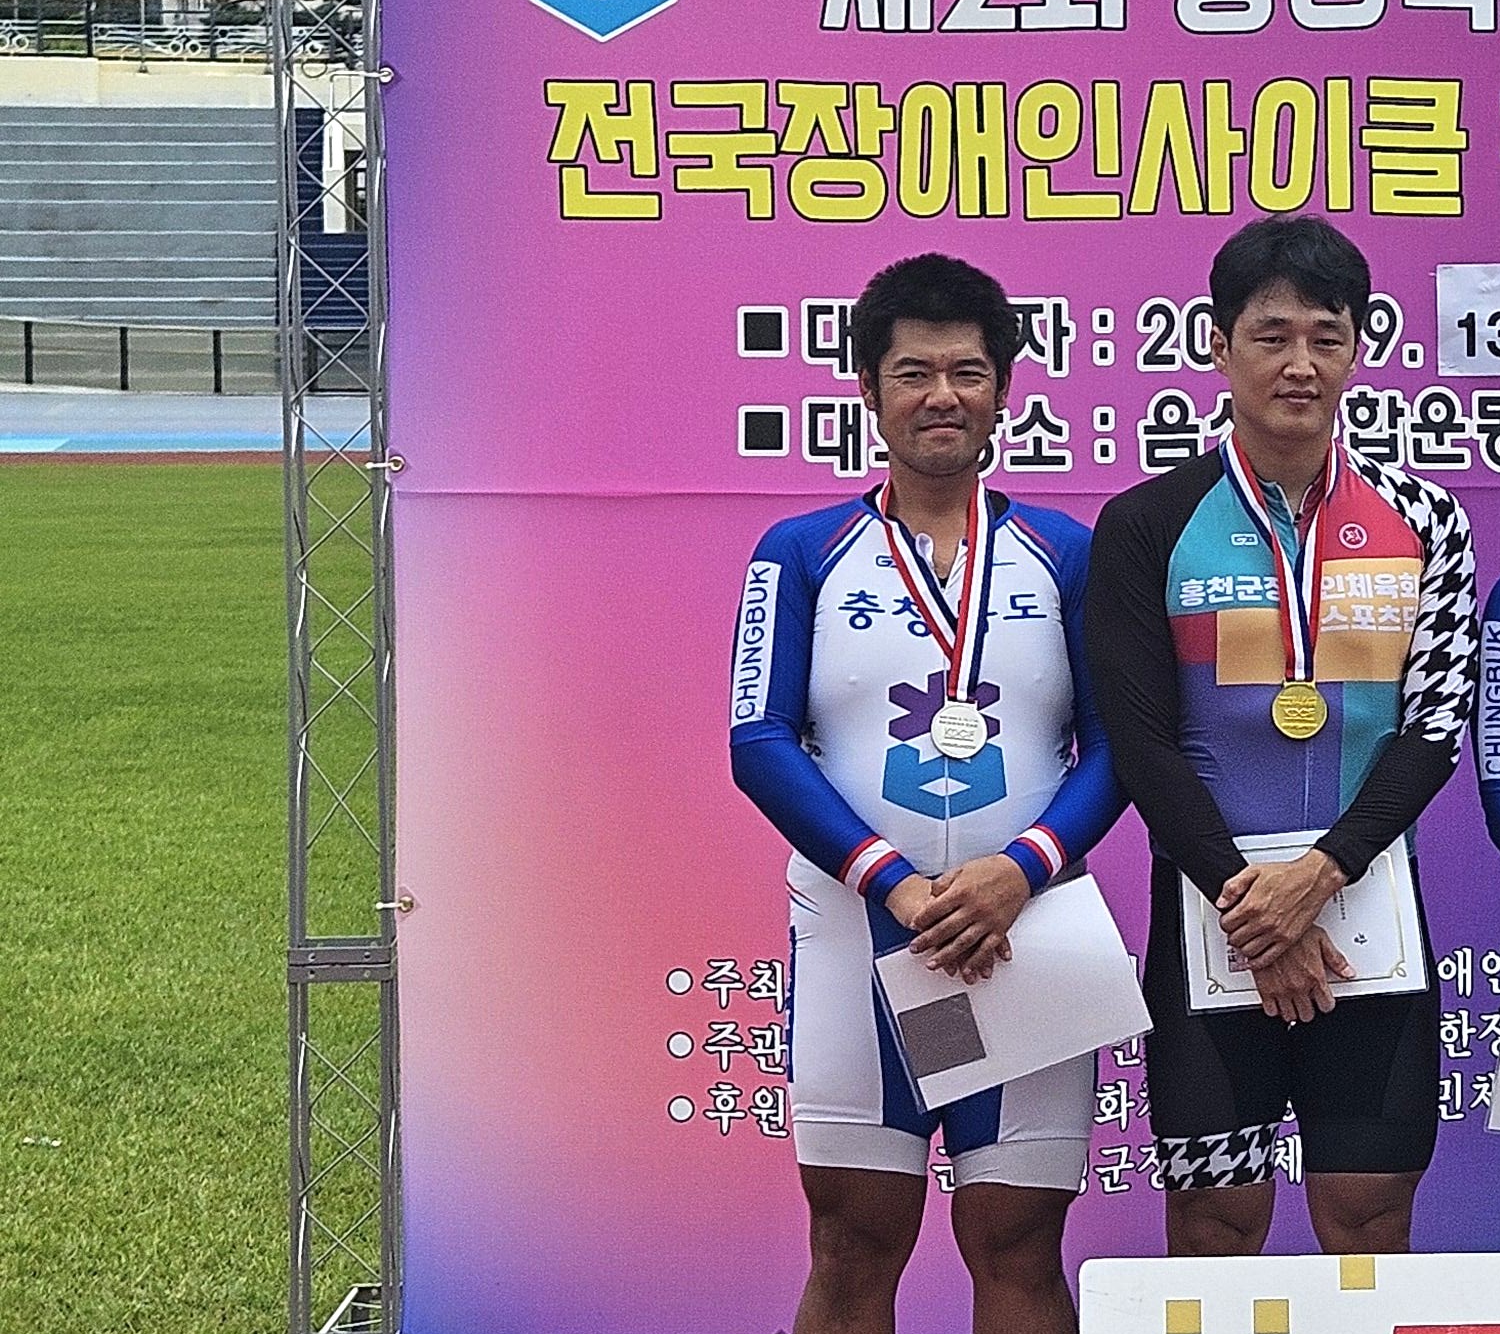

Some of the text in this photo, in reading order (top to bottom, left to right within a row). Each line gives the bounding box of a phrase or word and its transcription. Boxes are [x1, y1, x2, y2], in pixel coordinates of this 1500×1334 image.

[543, 75, 1468, 223] 전국장애인사이클
[837, 590, 1048, 638] 충청도
[734, 566, 772, 721] CHUNGBUK
[702, 959, 785, 1013] 주최
[702, 1021, 789, 1075] 주관
[703, 1082, 791, 1139] 후원
